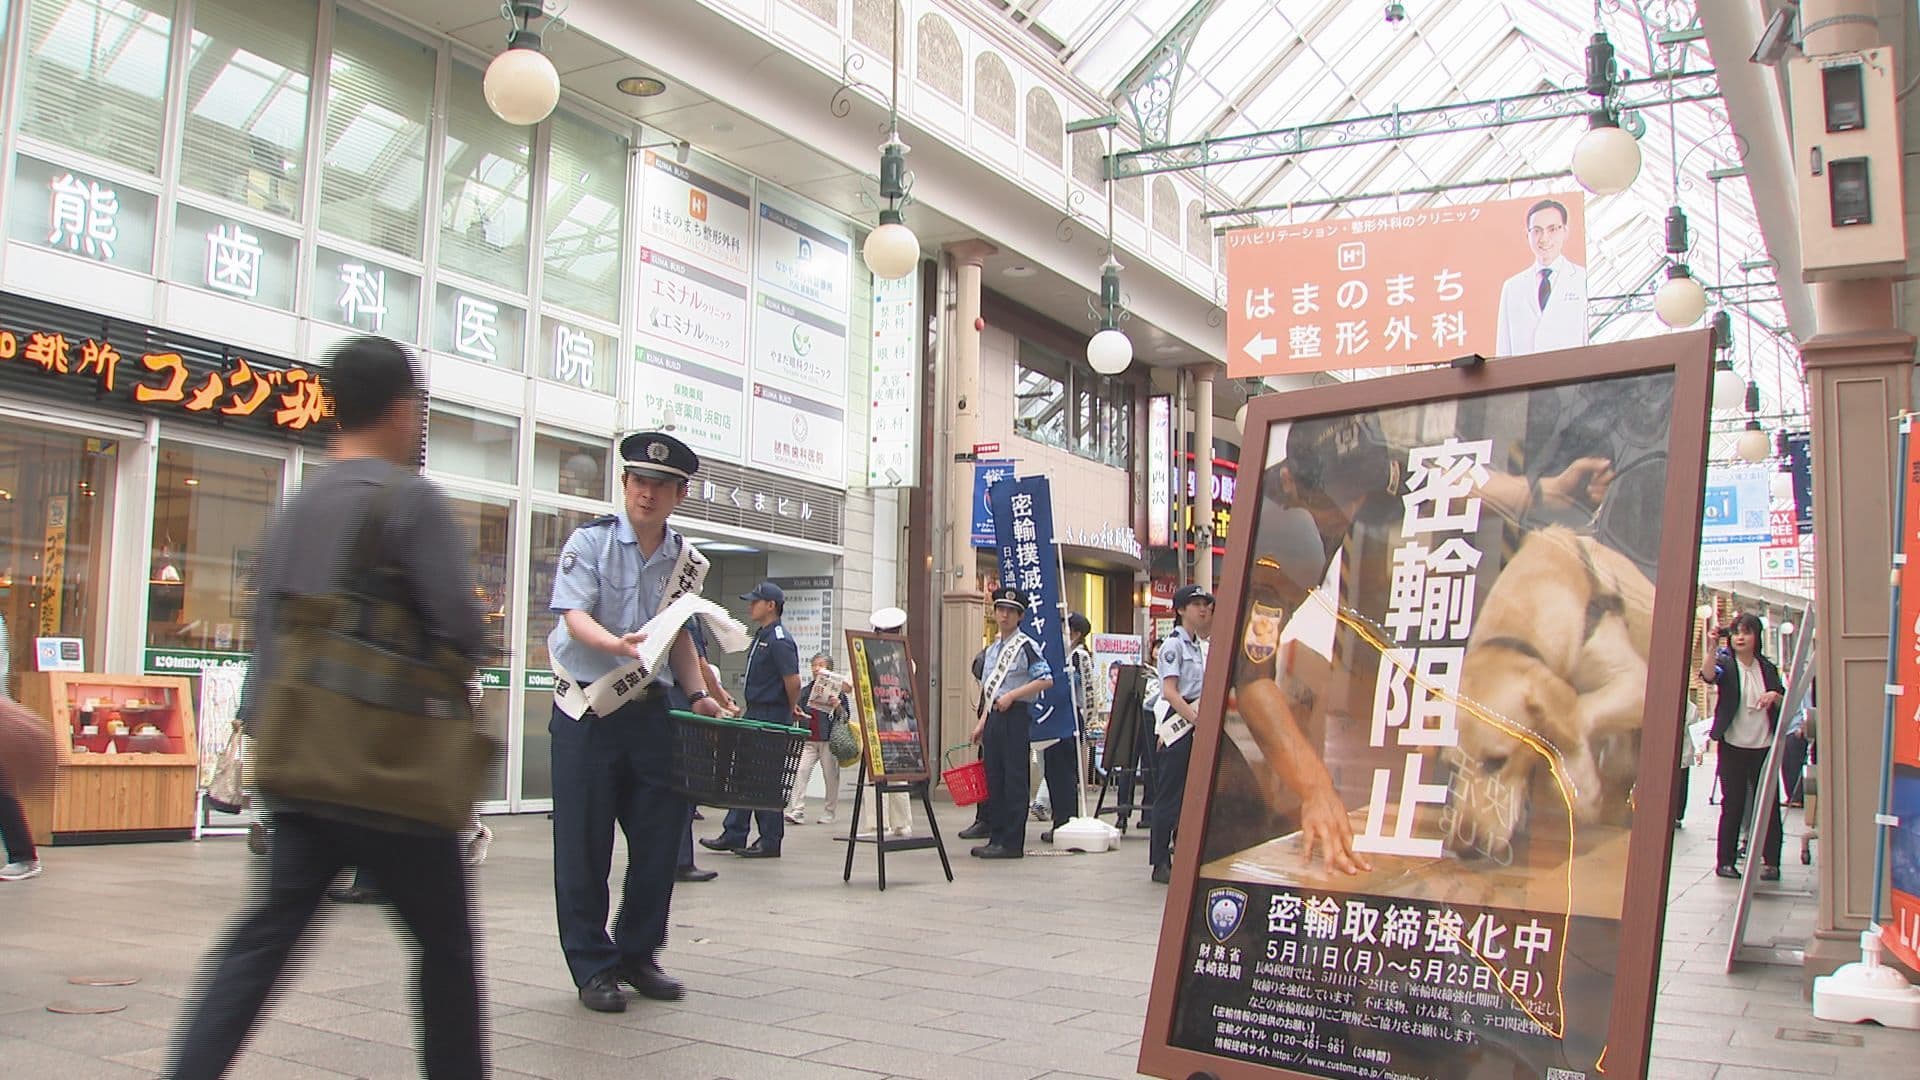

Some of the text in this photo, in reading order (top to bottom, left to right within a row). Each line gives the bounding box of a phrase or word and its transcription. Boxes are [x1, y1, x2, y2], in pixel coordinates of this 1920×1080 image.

[652, 204, 740, 255] はまのまち整形外科
[1229, 206, 1482, 248] リハビリテーション・整形外科のクリニック
[48, 173, 596, 390] 熊歯科医院
[652, 279, 733, 322] エミナルクリニック
[1245, 269, 1465, 320] はまのまち
[660, 314, 731, 349] エミナルクリニック
[1288, 312, 1467, 360] 整形外科
[646, 352, 665, 366] KUMA
[686, 480, 813, 521] 町くまビル
[1771, 525, 1793, 536] REE
[1011, 493, 1055, 724] 密輸撲滅キャン
[1353, 438, 1494, 859] 密輸阻止
[1267, 892, 1553, 966] 密輸取締強化中
[1194, 959, 1242, 980] 長崎税関
[1199, 943, 1242, 962] 財務省
[1214, 1036, 1270, 1057] 情報提供サイト
[1216, 1021, 1267, 1040] 密輸ダイヤル
[1272, 1032, 1345, 1055] 0120-461-961
